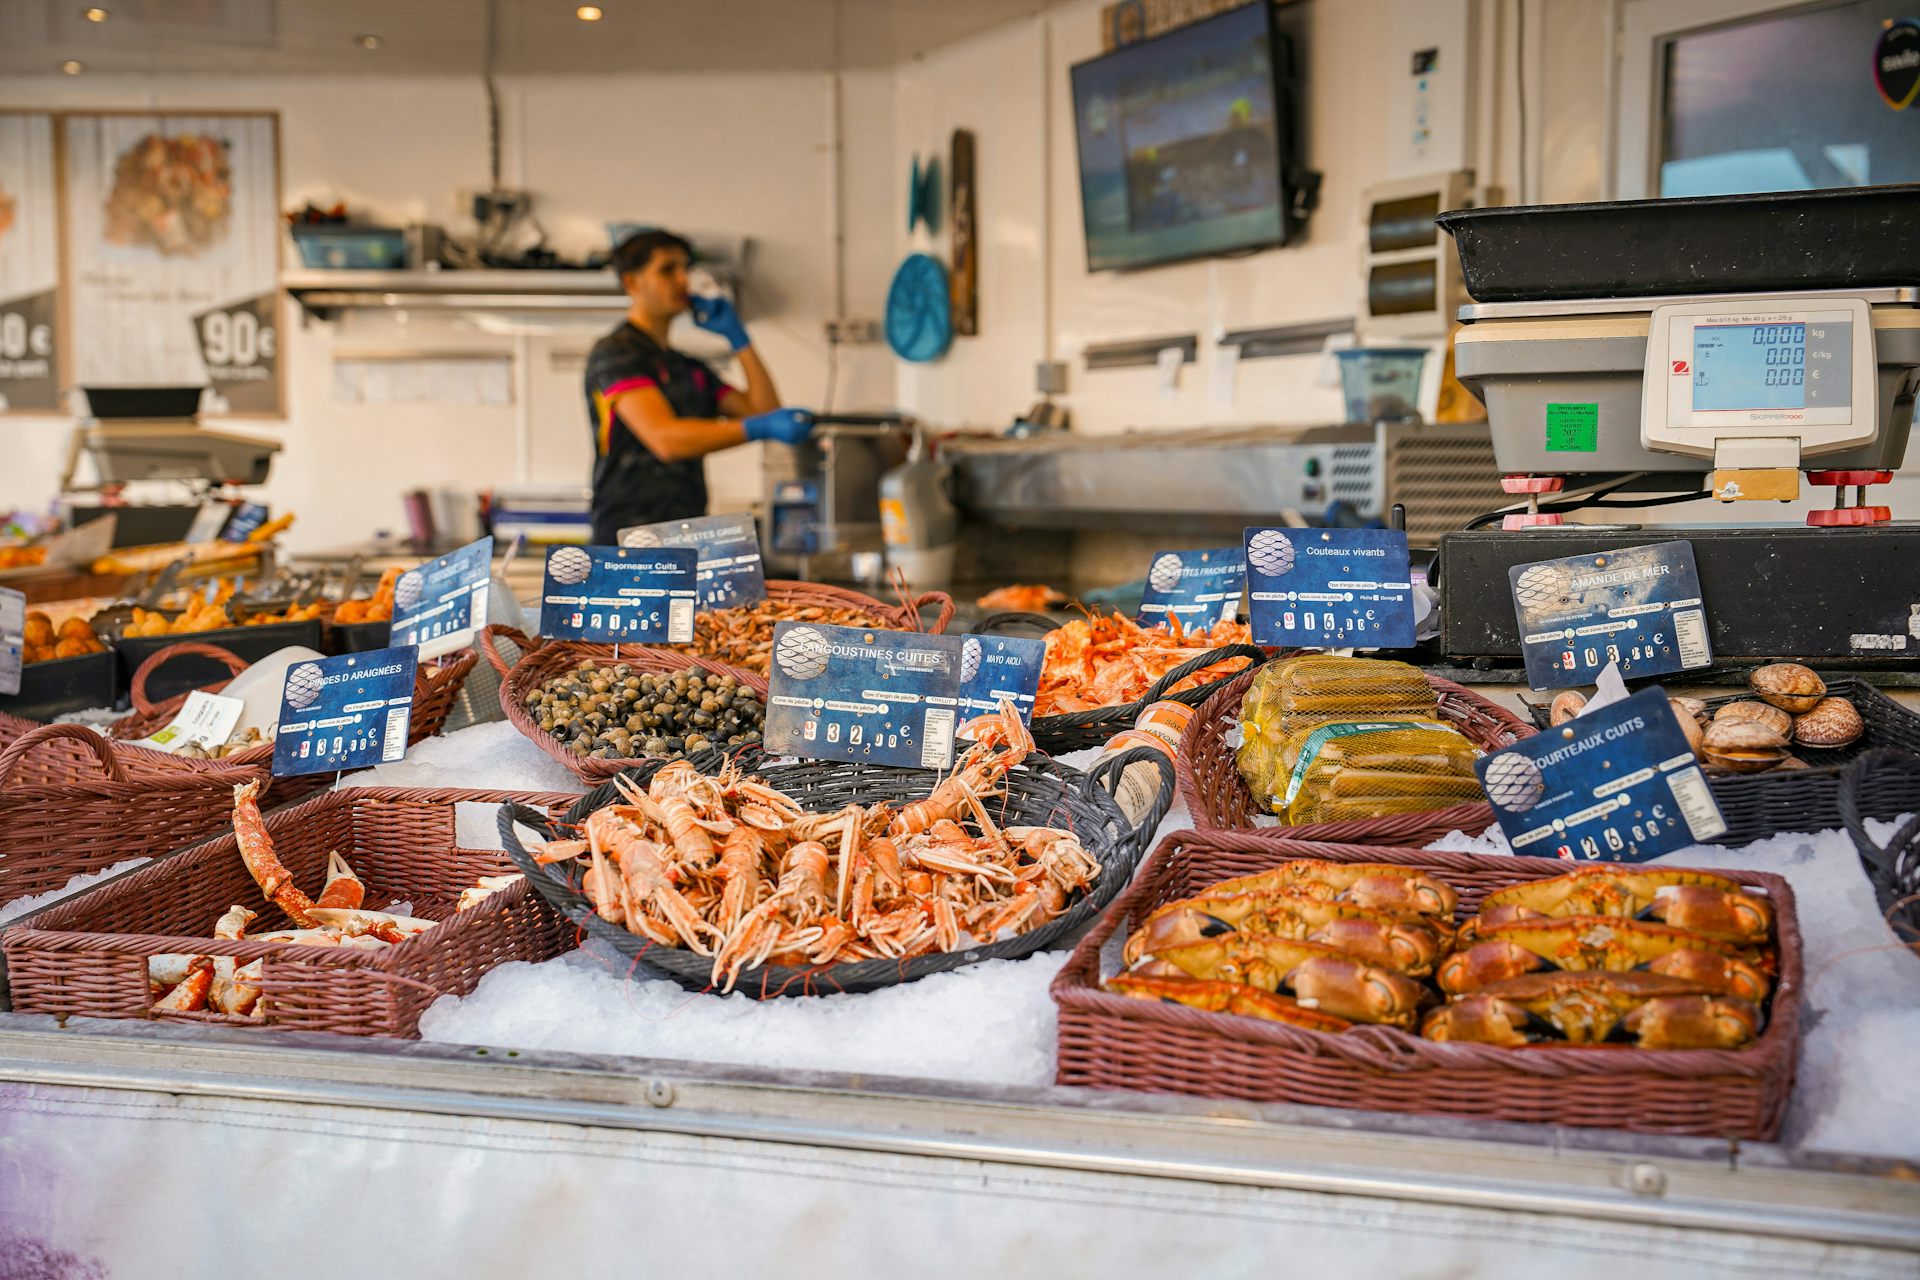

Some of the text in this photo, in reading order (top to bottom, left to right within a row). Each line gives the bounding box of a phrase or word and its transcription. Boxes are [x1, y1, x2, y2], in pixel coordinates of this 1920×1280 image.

[206, 311, 258, 365] 90
[1753, 327, 1825, 346] 0,000 kg
[1765, 348, 1831, 366] 0,00 €/kg
[1765, 369, 1820, 387] 0,00 €
[1306, 546, 1385, 557] Couteaux vivants
[604, 561, 677, 571] Bigorneaux Cuits
[1571, 565, 1670, 589] AMANDE DE MER
[650, 611, 659, 622] €
[1366, 609, 1375, 620] €
[1653, 633, 1664, 645] €
[800, 642, 941, 664] LANGOUSTINES CUITES
[986, 654, 1022, 666] MAYO AIOLI
[309, 664, 402, 687] PINCES D ARAIGNÉES
[368, 728, 377, 739] €
[899, 725, 911, 738] €
[1530, 716, 1645, 772] TOURTEAUX CUITS
[1652, 804, 1666, 819] €
